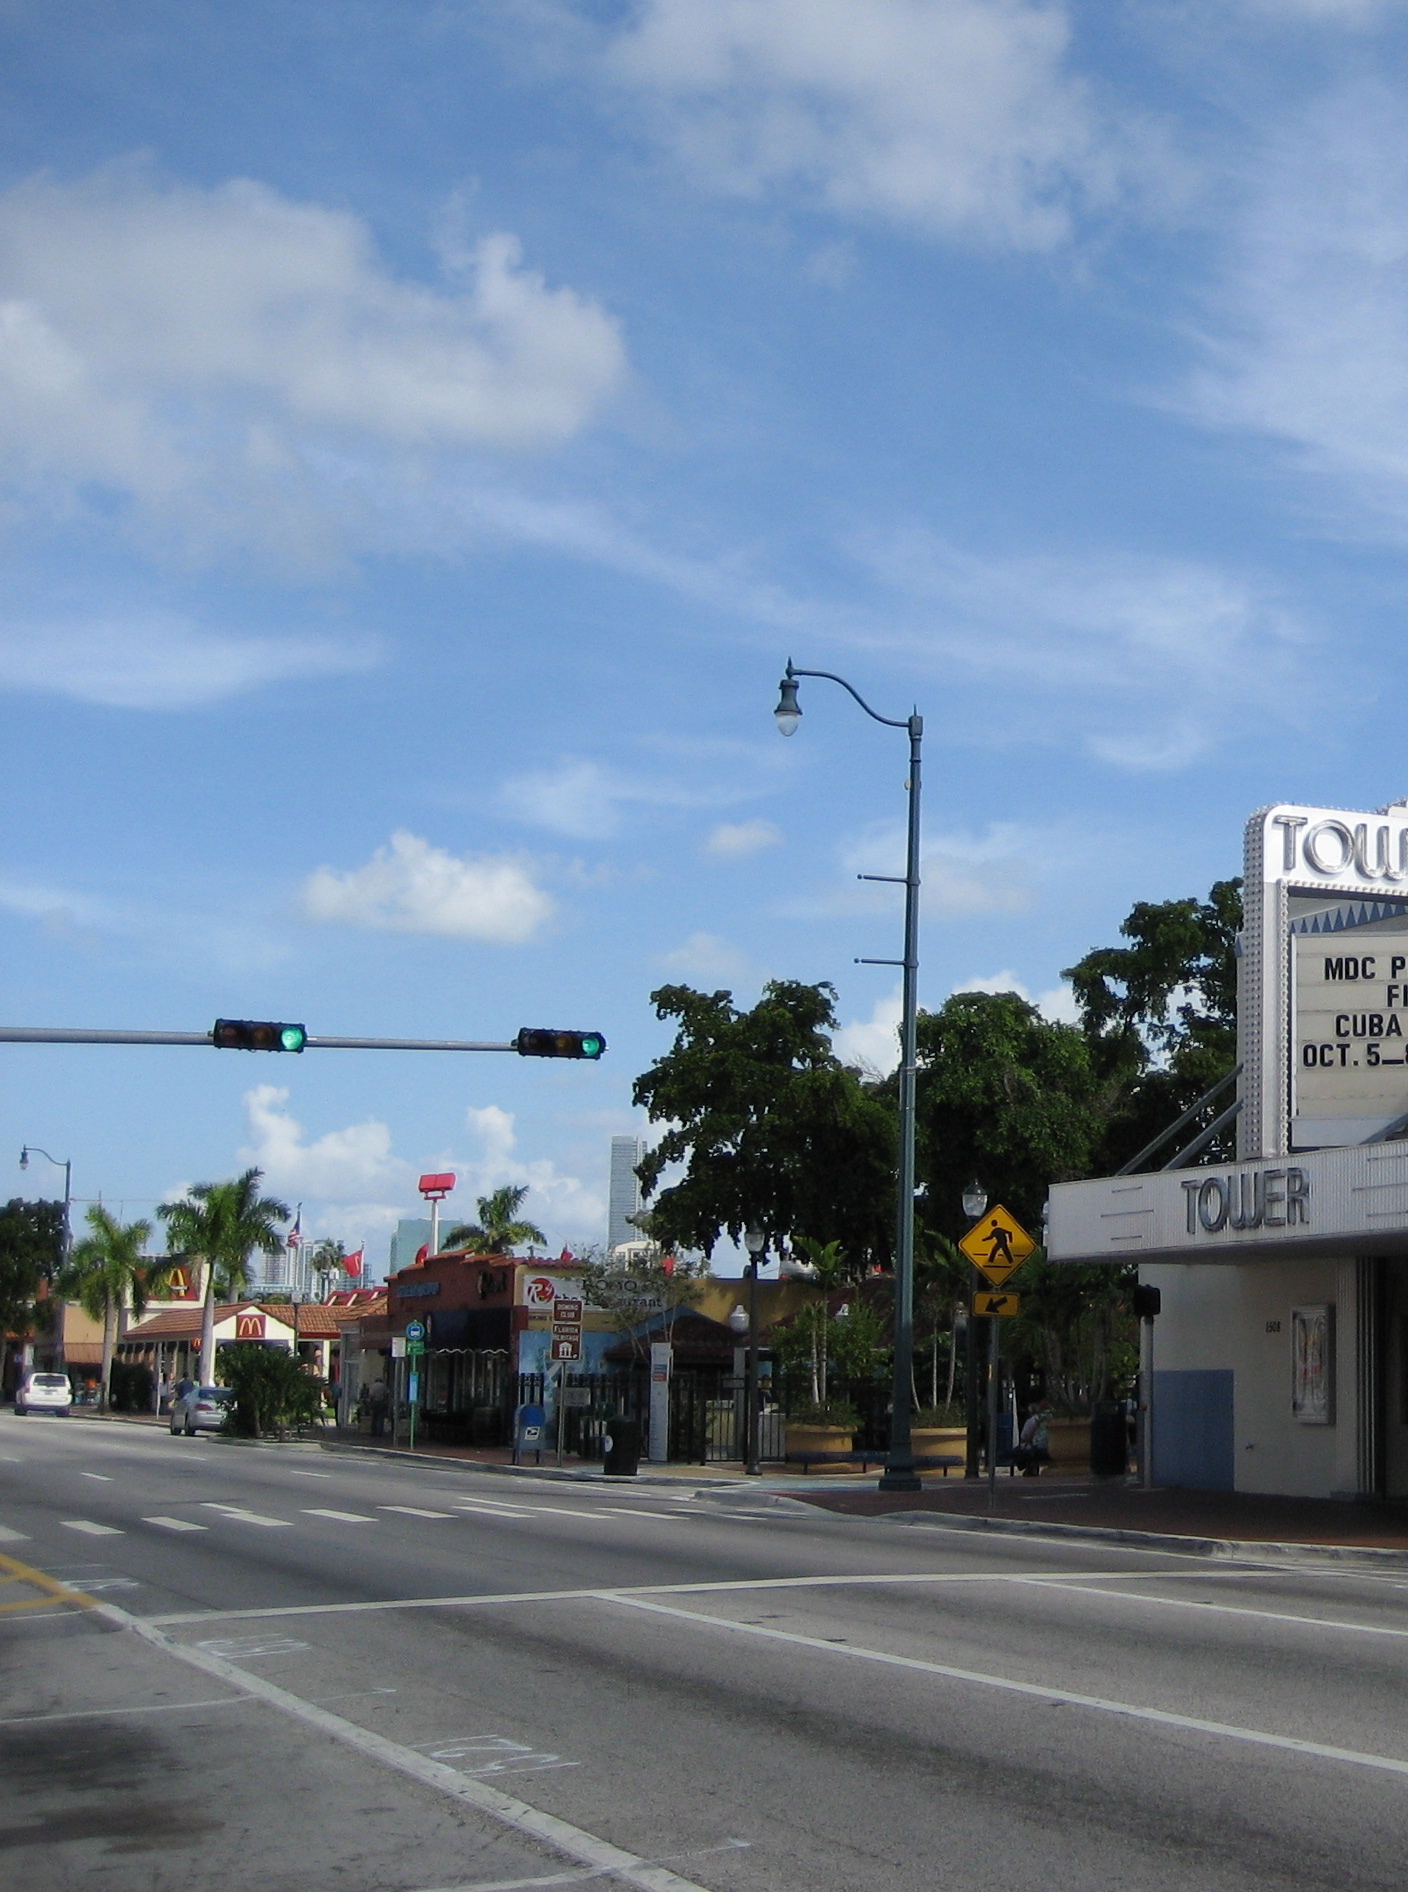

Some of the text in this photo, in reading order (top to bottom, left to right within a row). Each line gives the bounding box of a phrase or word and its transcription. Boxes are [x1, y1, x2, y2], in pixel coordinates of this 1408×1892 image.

[1324, 956, 1376, 980] MDC
[1335, 1013, 1403, 1037] CUBA
[1181, 1167, 1310, 1235] TOWER
